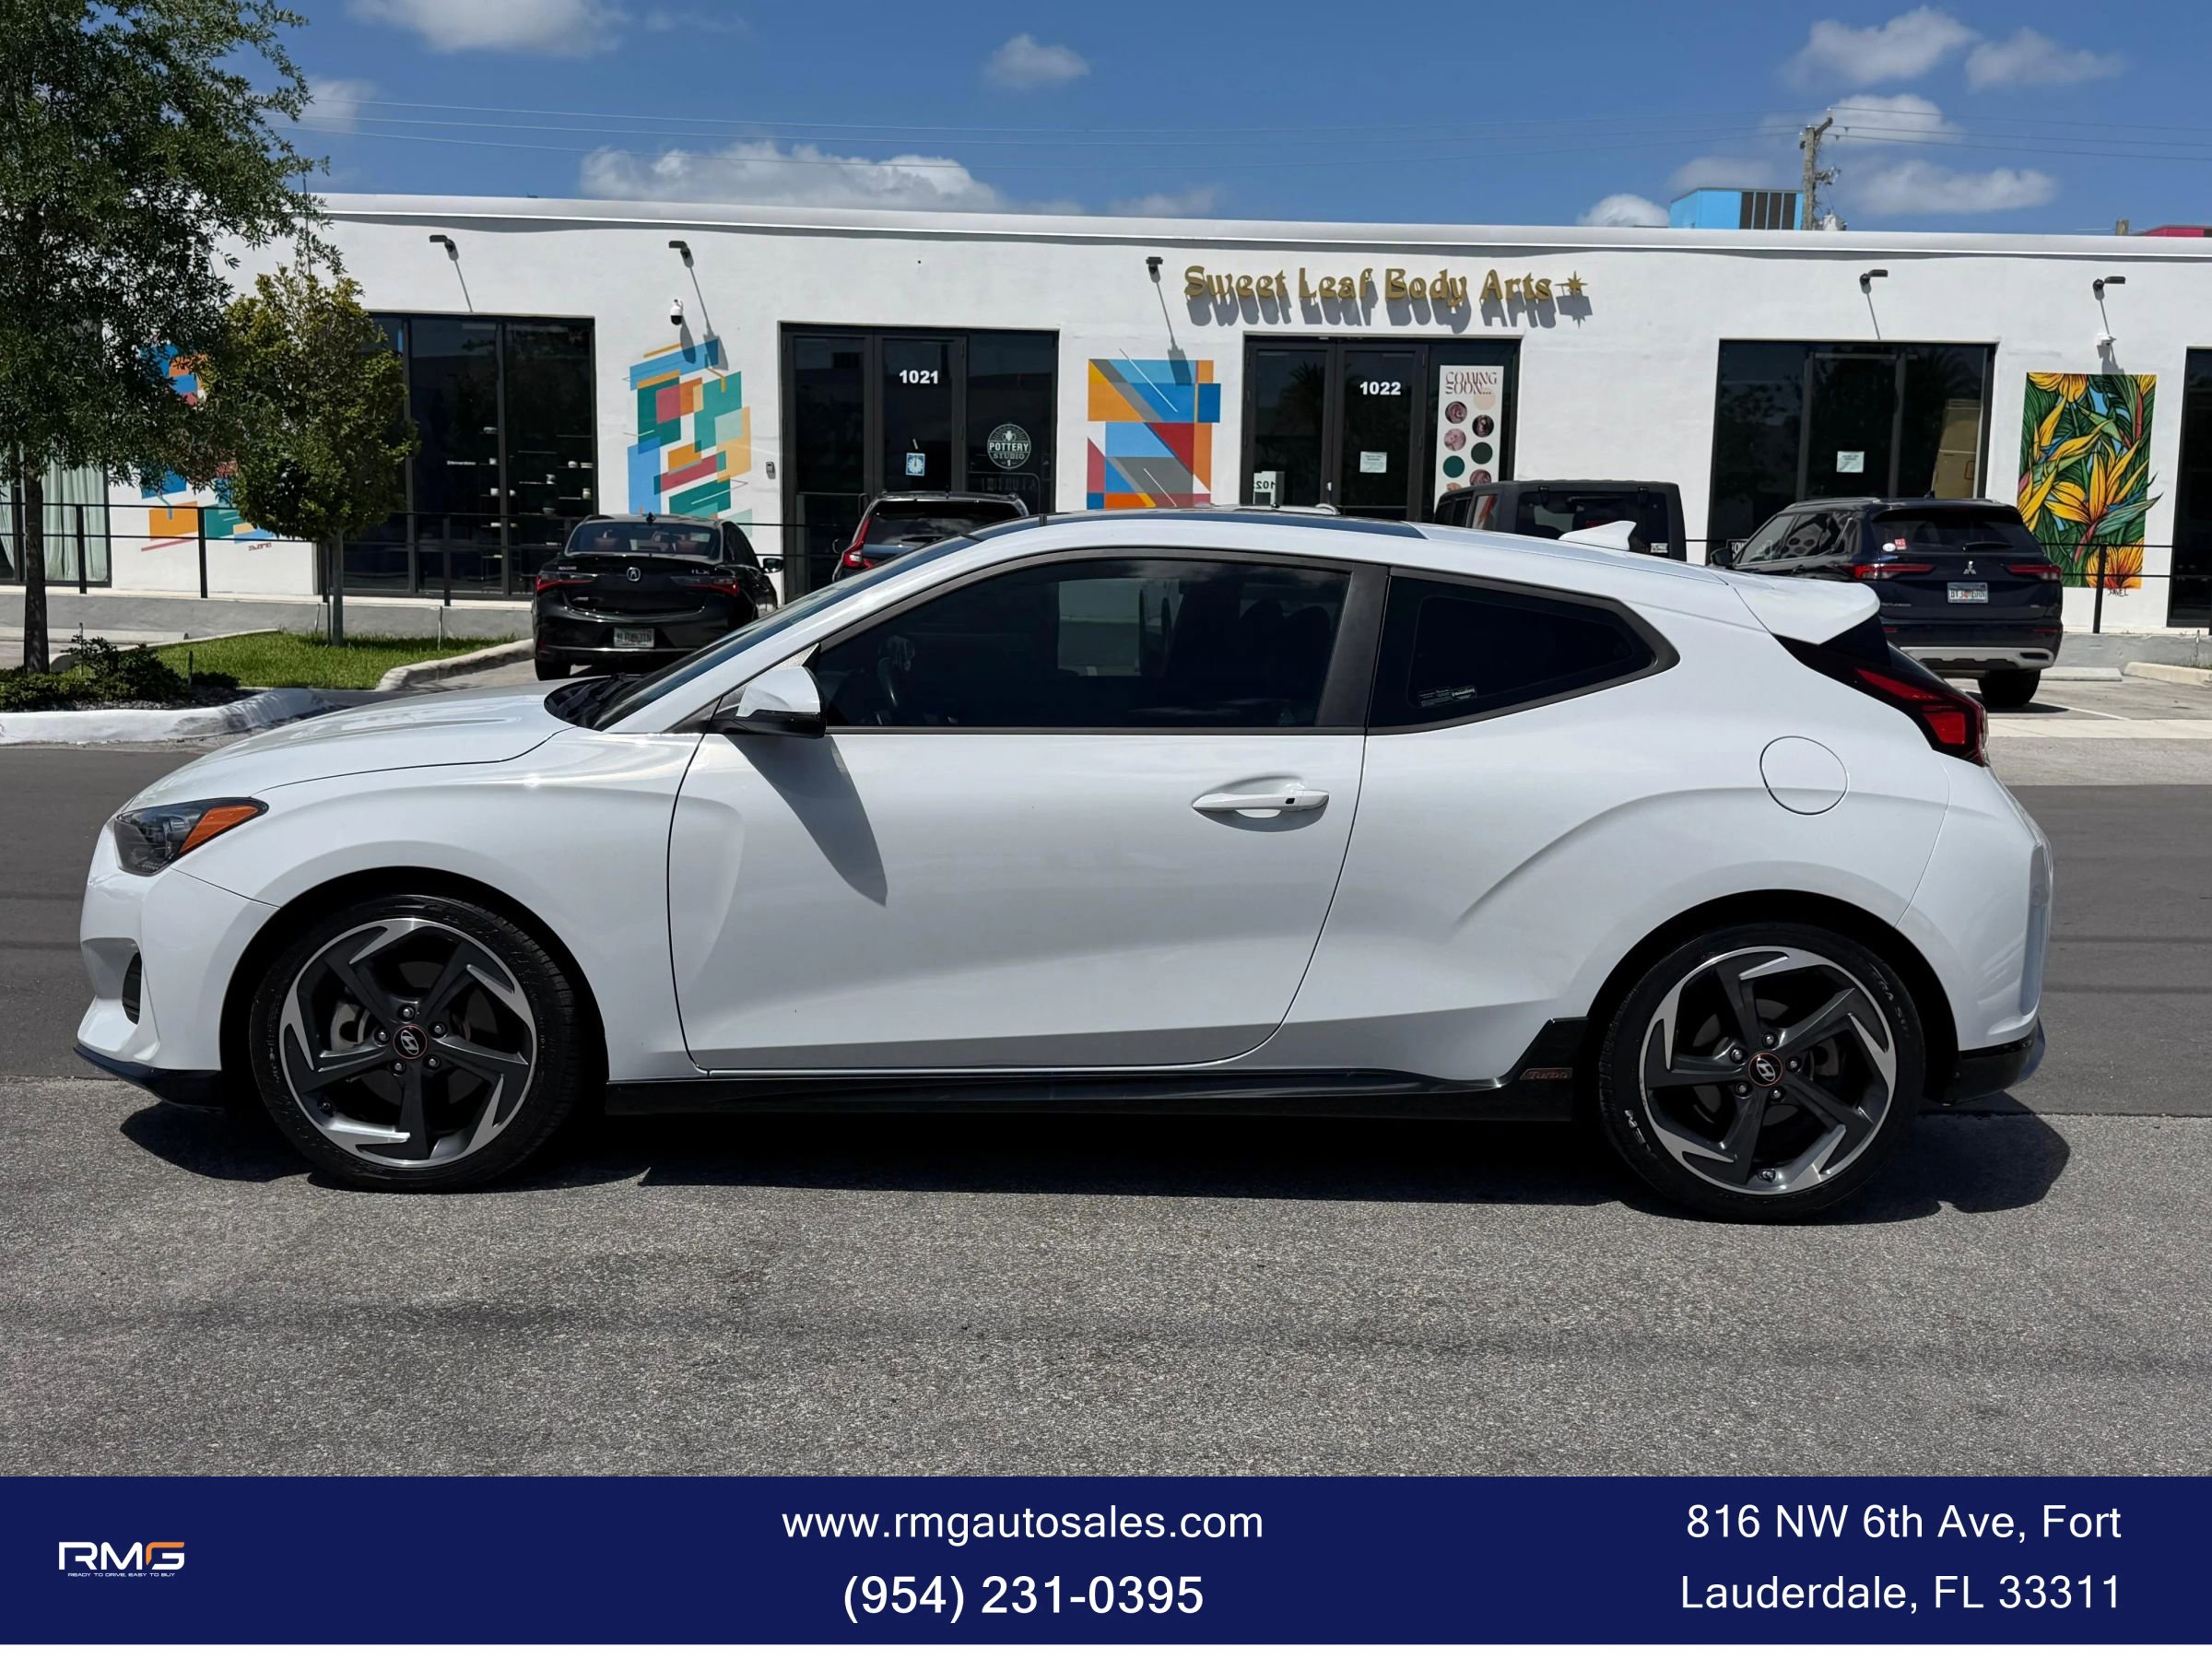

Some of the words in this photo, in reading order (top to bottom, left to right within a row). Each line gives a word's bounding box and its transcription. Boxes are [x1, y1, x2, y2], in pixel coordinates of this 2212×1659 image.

[1184, 265, 1286, 298] Sweet
[1299, 268, 1373, 299] Leaf
[1384, 268, 1467, 308] Body
[1481, 269, 1552, 300] Arts
[899, 370, 939, 384] 1021
[1445, 371, 1498, 385] COMING
[1359, 381, 1402, 395] 1022
[989, 442, 1029, 452] POTTERY
